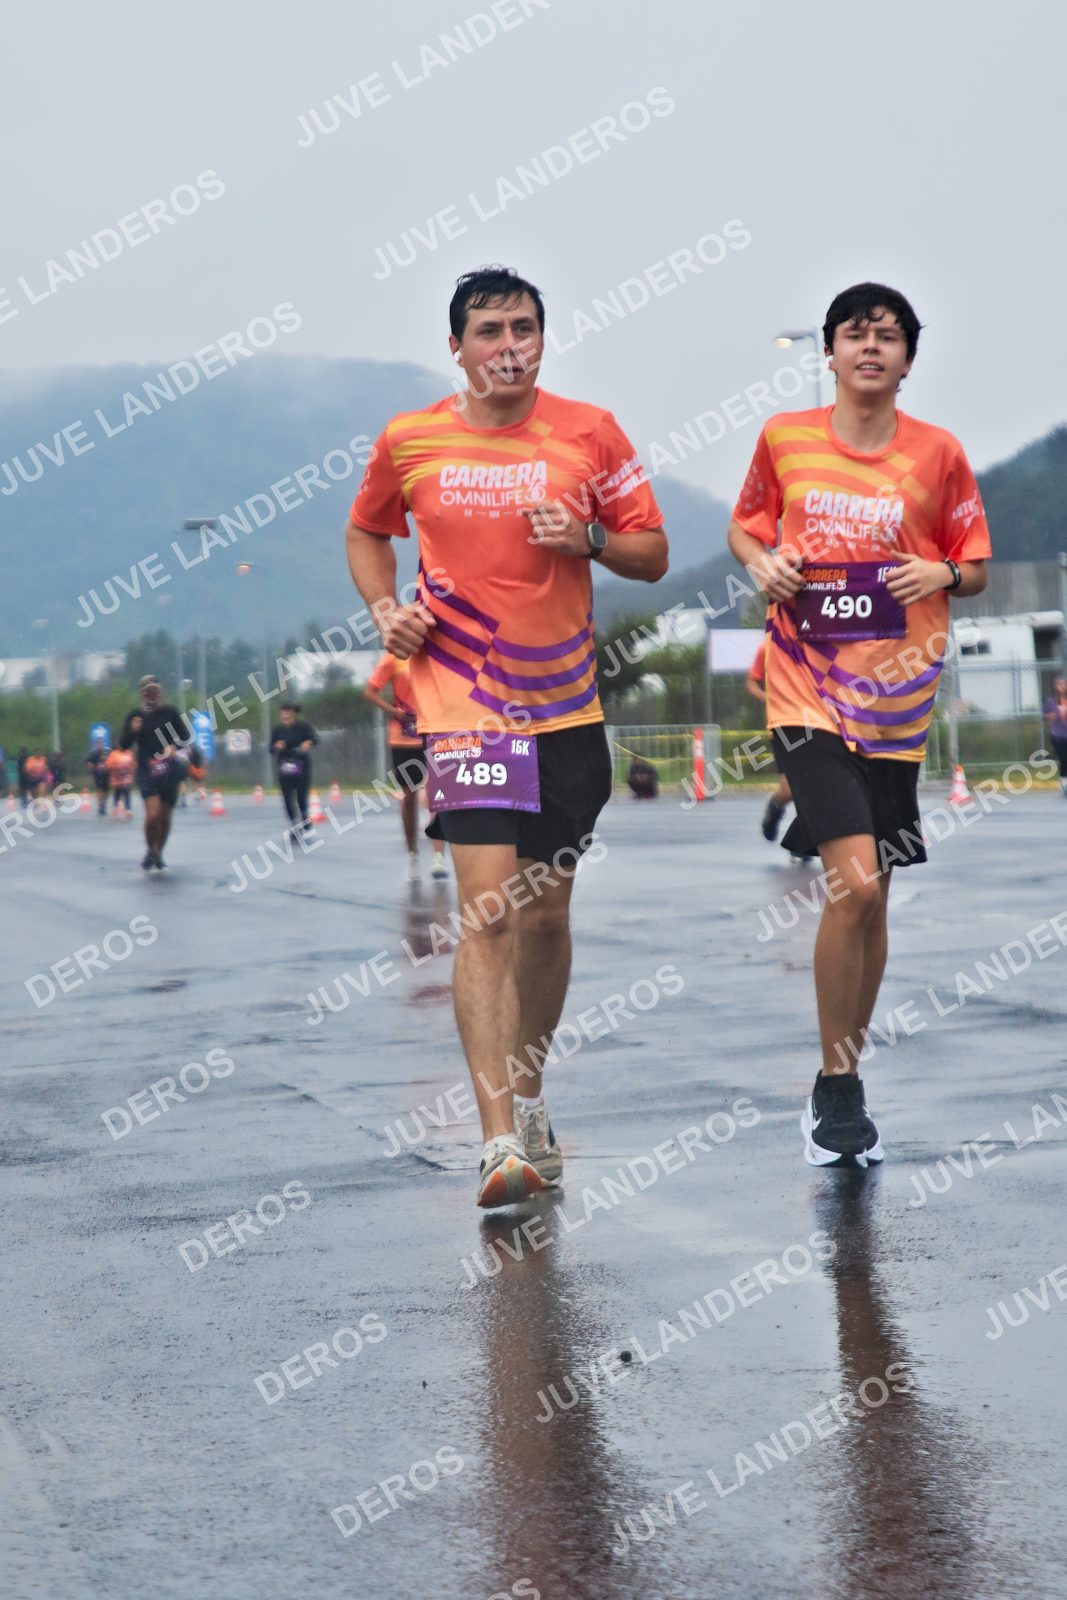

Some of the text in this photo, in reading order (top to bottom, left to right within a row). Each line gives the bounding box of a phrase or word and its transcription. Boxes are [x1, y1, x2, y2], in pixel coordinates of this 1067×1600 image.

[439, 460, 547, 488] CARRERA
[440, 489, 523, 507] OMNILIFE
[804, 489, 904, 527] CARRERA
[802, 569, 847, 582] CARRERA
[821, 594, 873, 619] 490
[434, 736, 482, 752] CARRERA
[434, 750, 471, 760] OMNILIFE
[456, 762, 507, 786] 489
